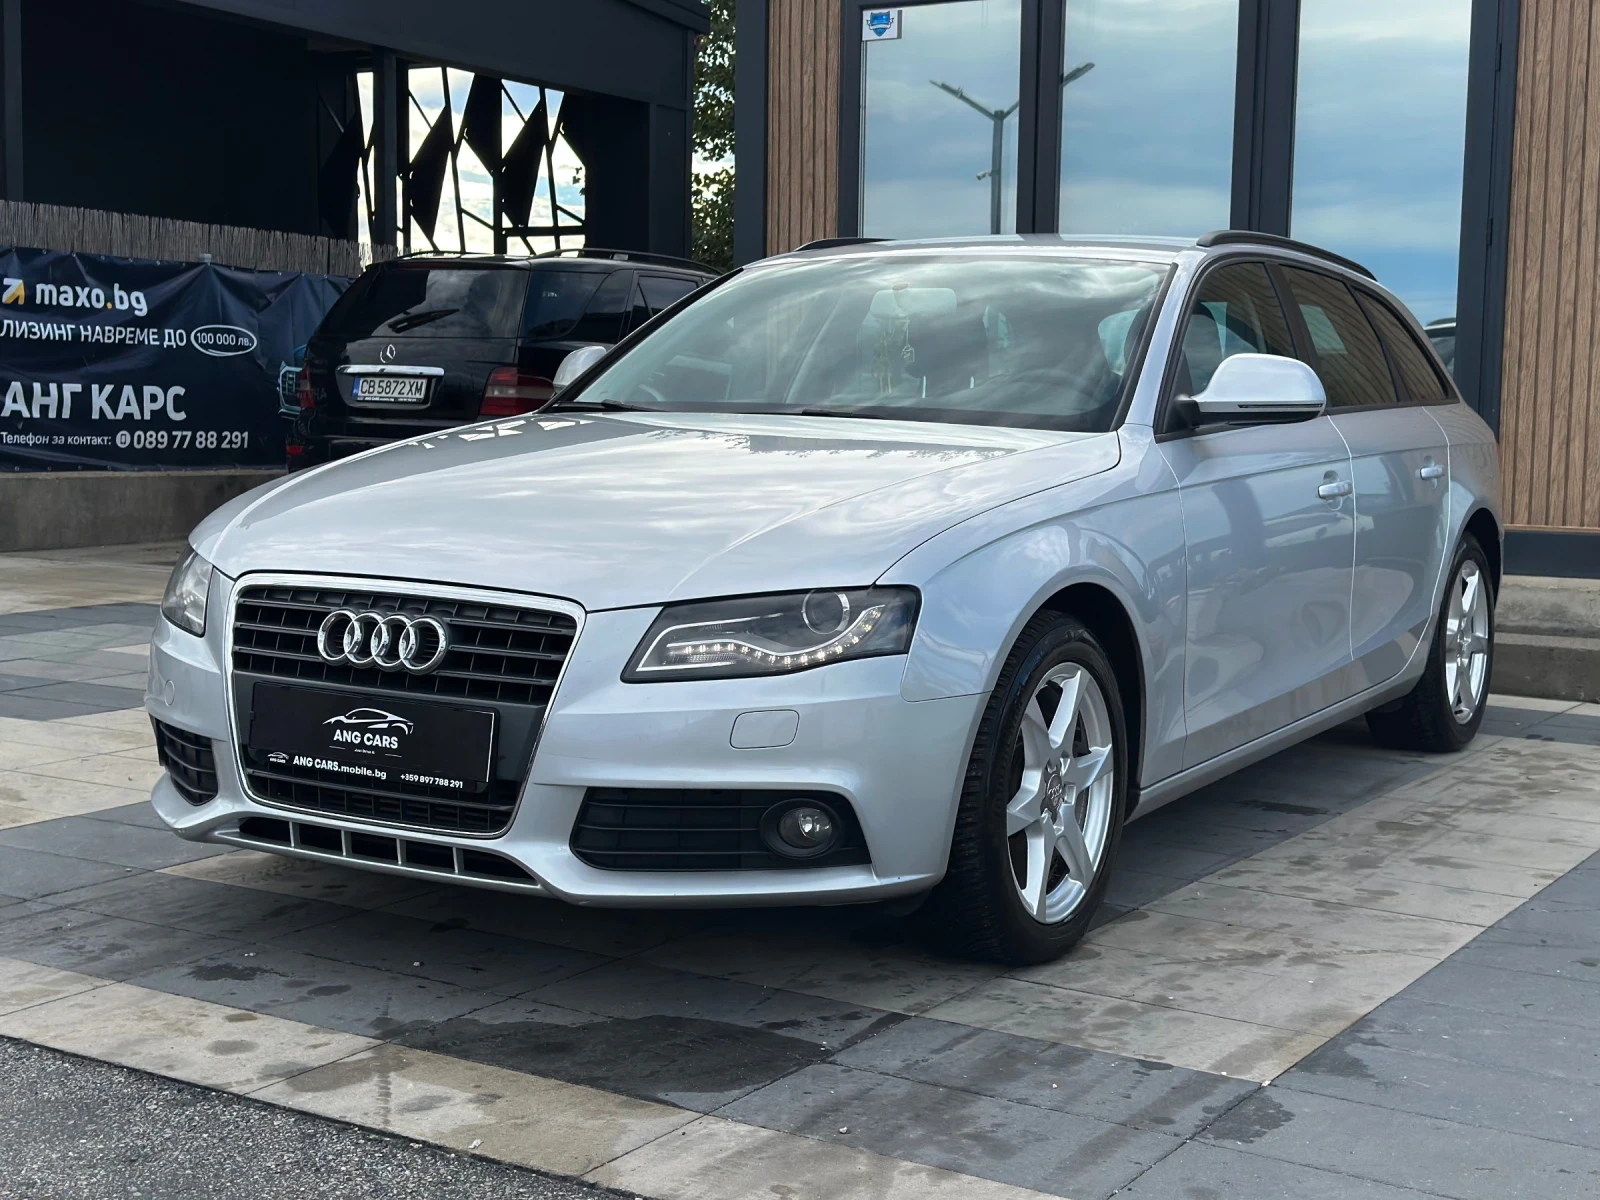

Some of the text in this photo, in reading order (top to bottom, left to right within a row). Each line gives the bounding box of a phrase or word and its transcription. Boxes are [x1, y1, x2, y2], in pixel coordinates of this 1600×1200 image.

[35, 283, 148, 317] maxo.bg
[0, 319, 252, 349] ЛИЗИНГ НАВРЕМЕ ДО 100 000 лв.
[0, 380, 187, 421] АНГ КАРС
[360, 379, 376, 395] CB
[376, 379, 407, 396] 5872
[406, 380, 424, 396] XM
[0, 430, 249, 449] Телефон за контакт: 089 77 88 291
[333, 728, 399, 749] ANG CARS
[292, 755, 463, 789] ANG CARS.mobile.bg +359 897 788 291
